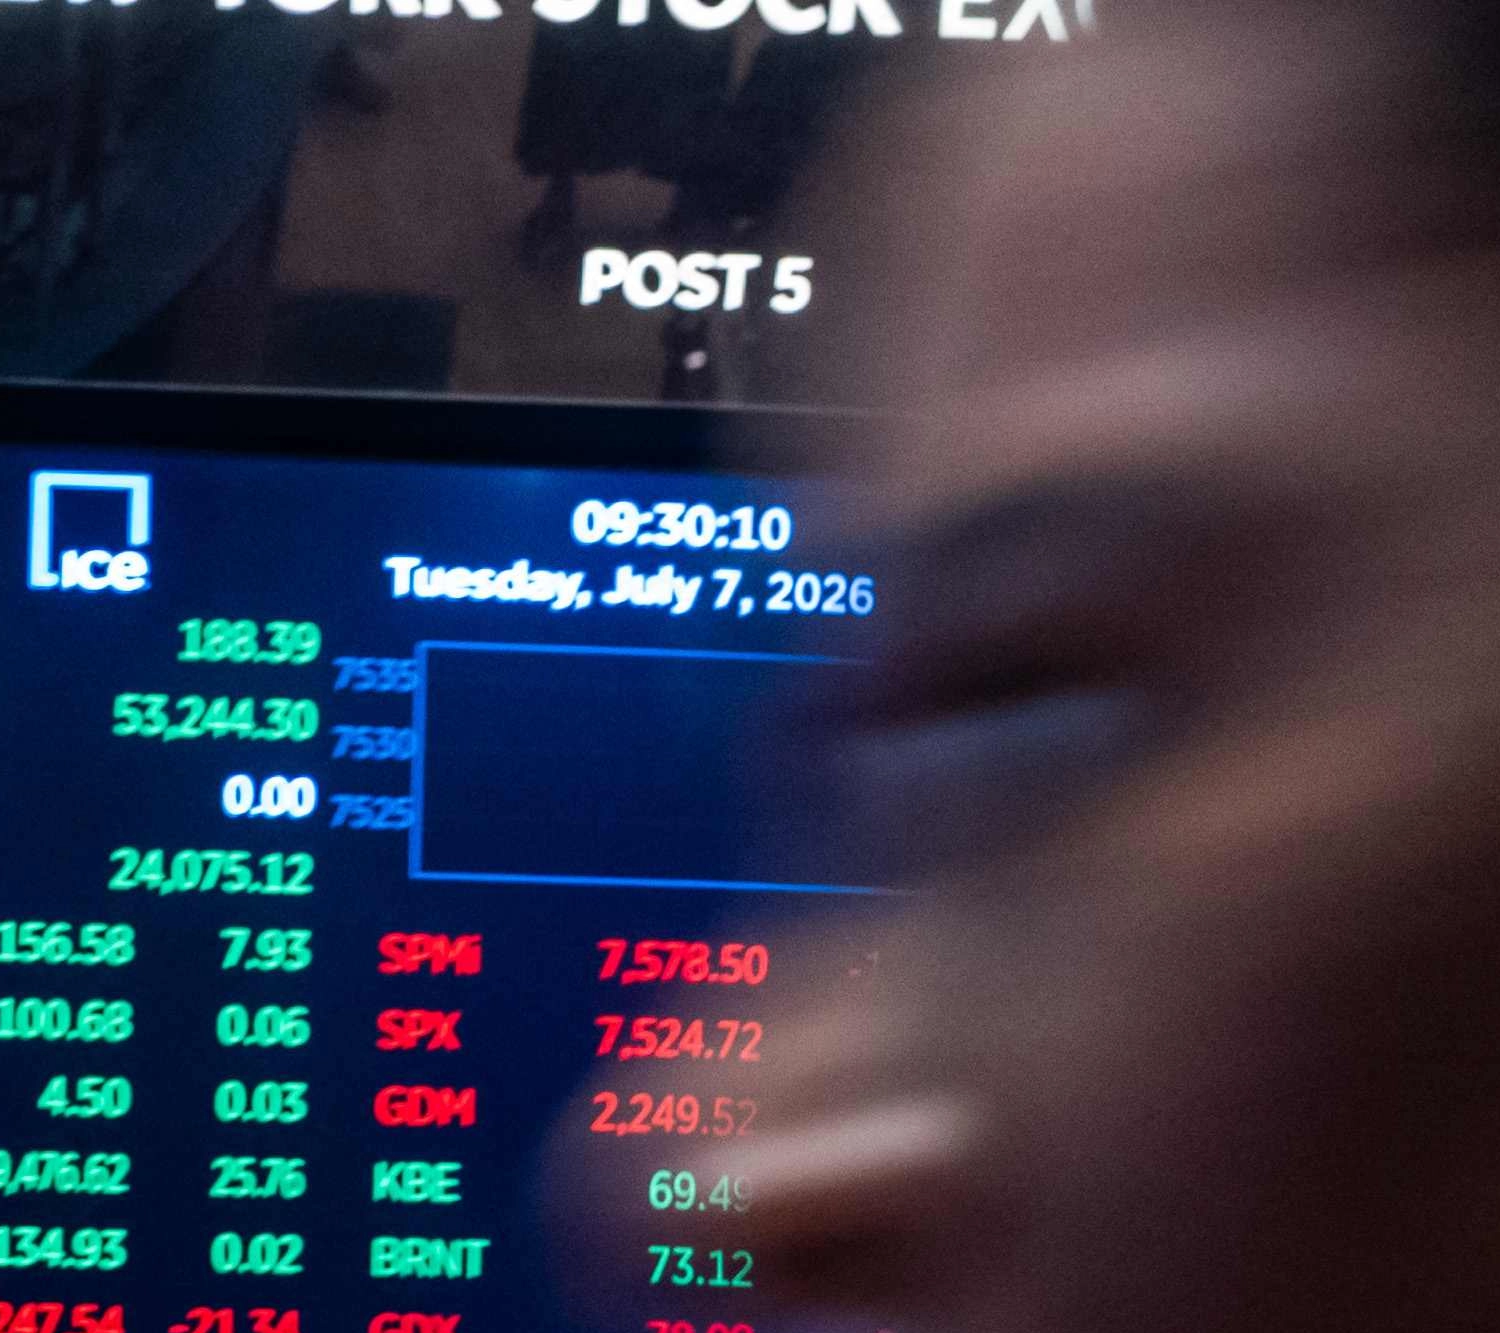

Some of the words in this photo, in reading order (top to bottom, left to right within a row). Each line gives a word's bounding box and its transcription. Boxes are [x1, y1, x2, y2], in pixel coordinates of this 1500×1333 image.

[579, 249, 760, 311] POST
[769, 256, 812, 314] 5
[571, 498, 793, 552] 09:30:10
[382, 554, 595, 613] Tuesday,
[600, 563, 702, 616] July
[710, 567, 757, 617] 7,
[763, 571, 876, 617] 2026
[177, 618, 322, 665] 188.39
[111, 692, 321, 742] 53,244.30
[222, 773, 319, 819] 0.00
[107, 847, 316, 896] 24,075.12
[218, 928, 314, 972] 7.93
[596, 938, 770, 987] 7,578.50
[215, 1004, 312, 1048] 0.06
[375, 1008, 463, 1052] SPX
[593, 1013, 764, 1064] 7,524.72
[36, 1074, 134, 1120] 4.50
[213, 1080, 310, 1125] 0.03
[371, 1085, 478, 1129] GDM
[589, 1091, 757, 1138] 2,249.52
[208, 1155, 308, 1200] 25.76
[371, 1161, 464, 1205] KBE
[210, 1232, 306, 1277] 0.02
[368, 1236, 493, 1280] BRNT
[646, 1243, 756, 1289] 73.12
